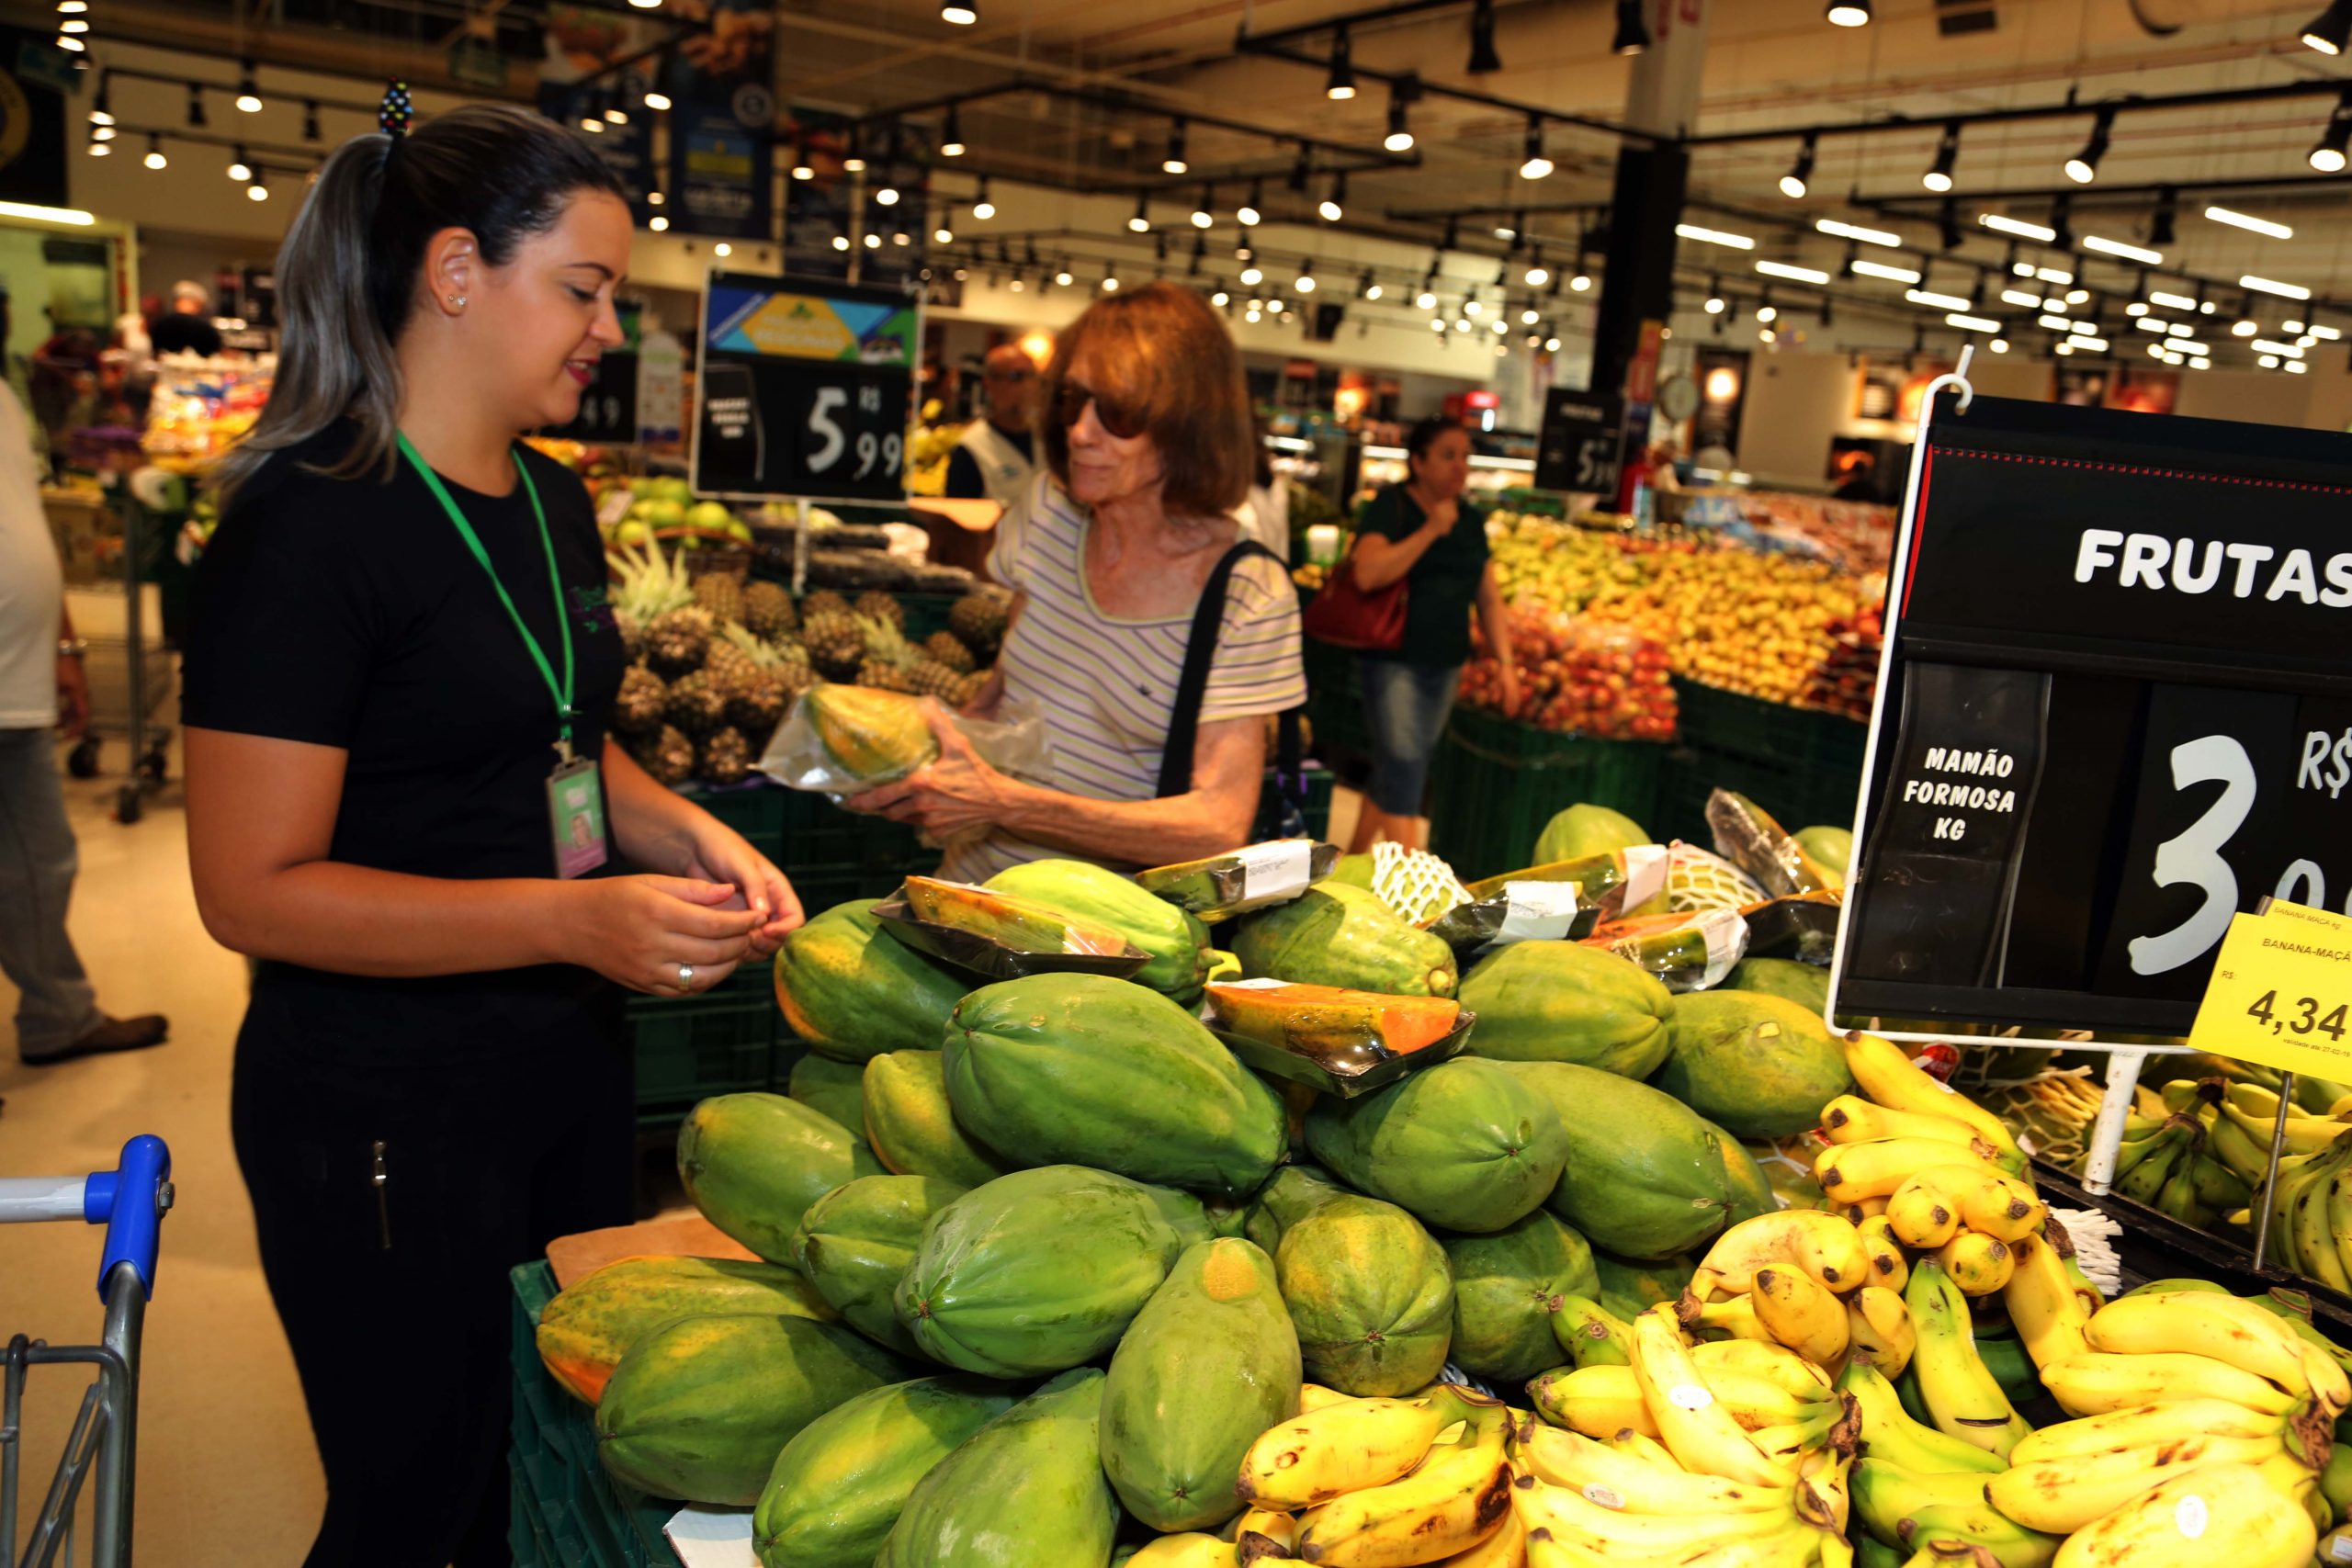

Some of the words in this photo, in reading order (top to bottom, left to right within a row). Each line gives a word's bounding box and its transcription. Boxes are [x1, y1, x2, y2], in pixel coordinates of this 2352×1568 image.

[807, 387, 848, 473] 5
[853, 432, 903, 482] 99
[2074, 528, 2352, 609] FRUTAS
[1924, 747, 2015, 778] MAMÃO
[2297, 728, 2352, 799] R$
[1903, 780, 2016, 813] FORMOSA
[1933, 817, 1966, 841] KG
[2127, 735, 2257, 976] 3
[2273, 906, 2306, 920] BANANA
[2262, 938, 2352, 962] BANANA-MAÇÃ
[2247, 989, 2350, 1042] 4,34
